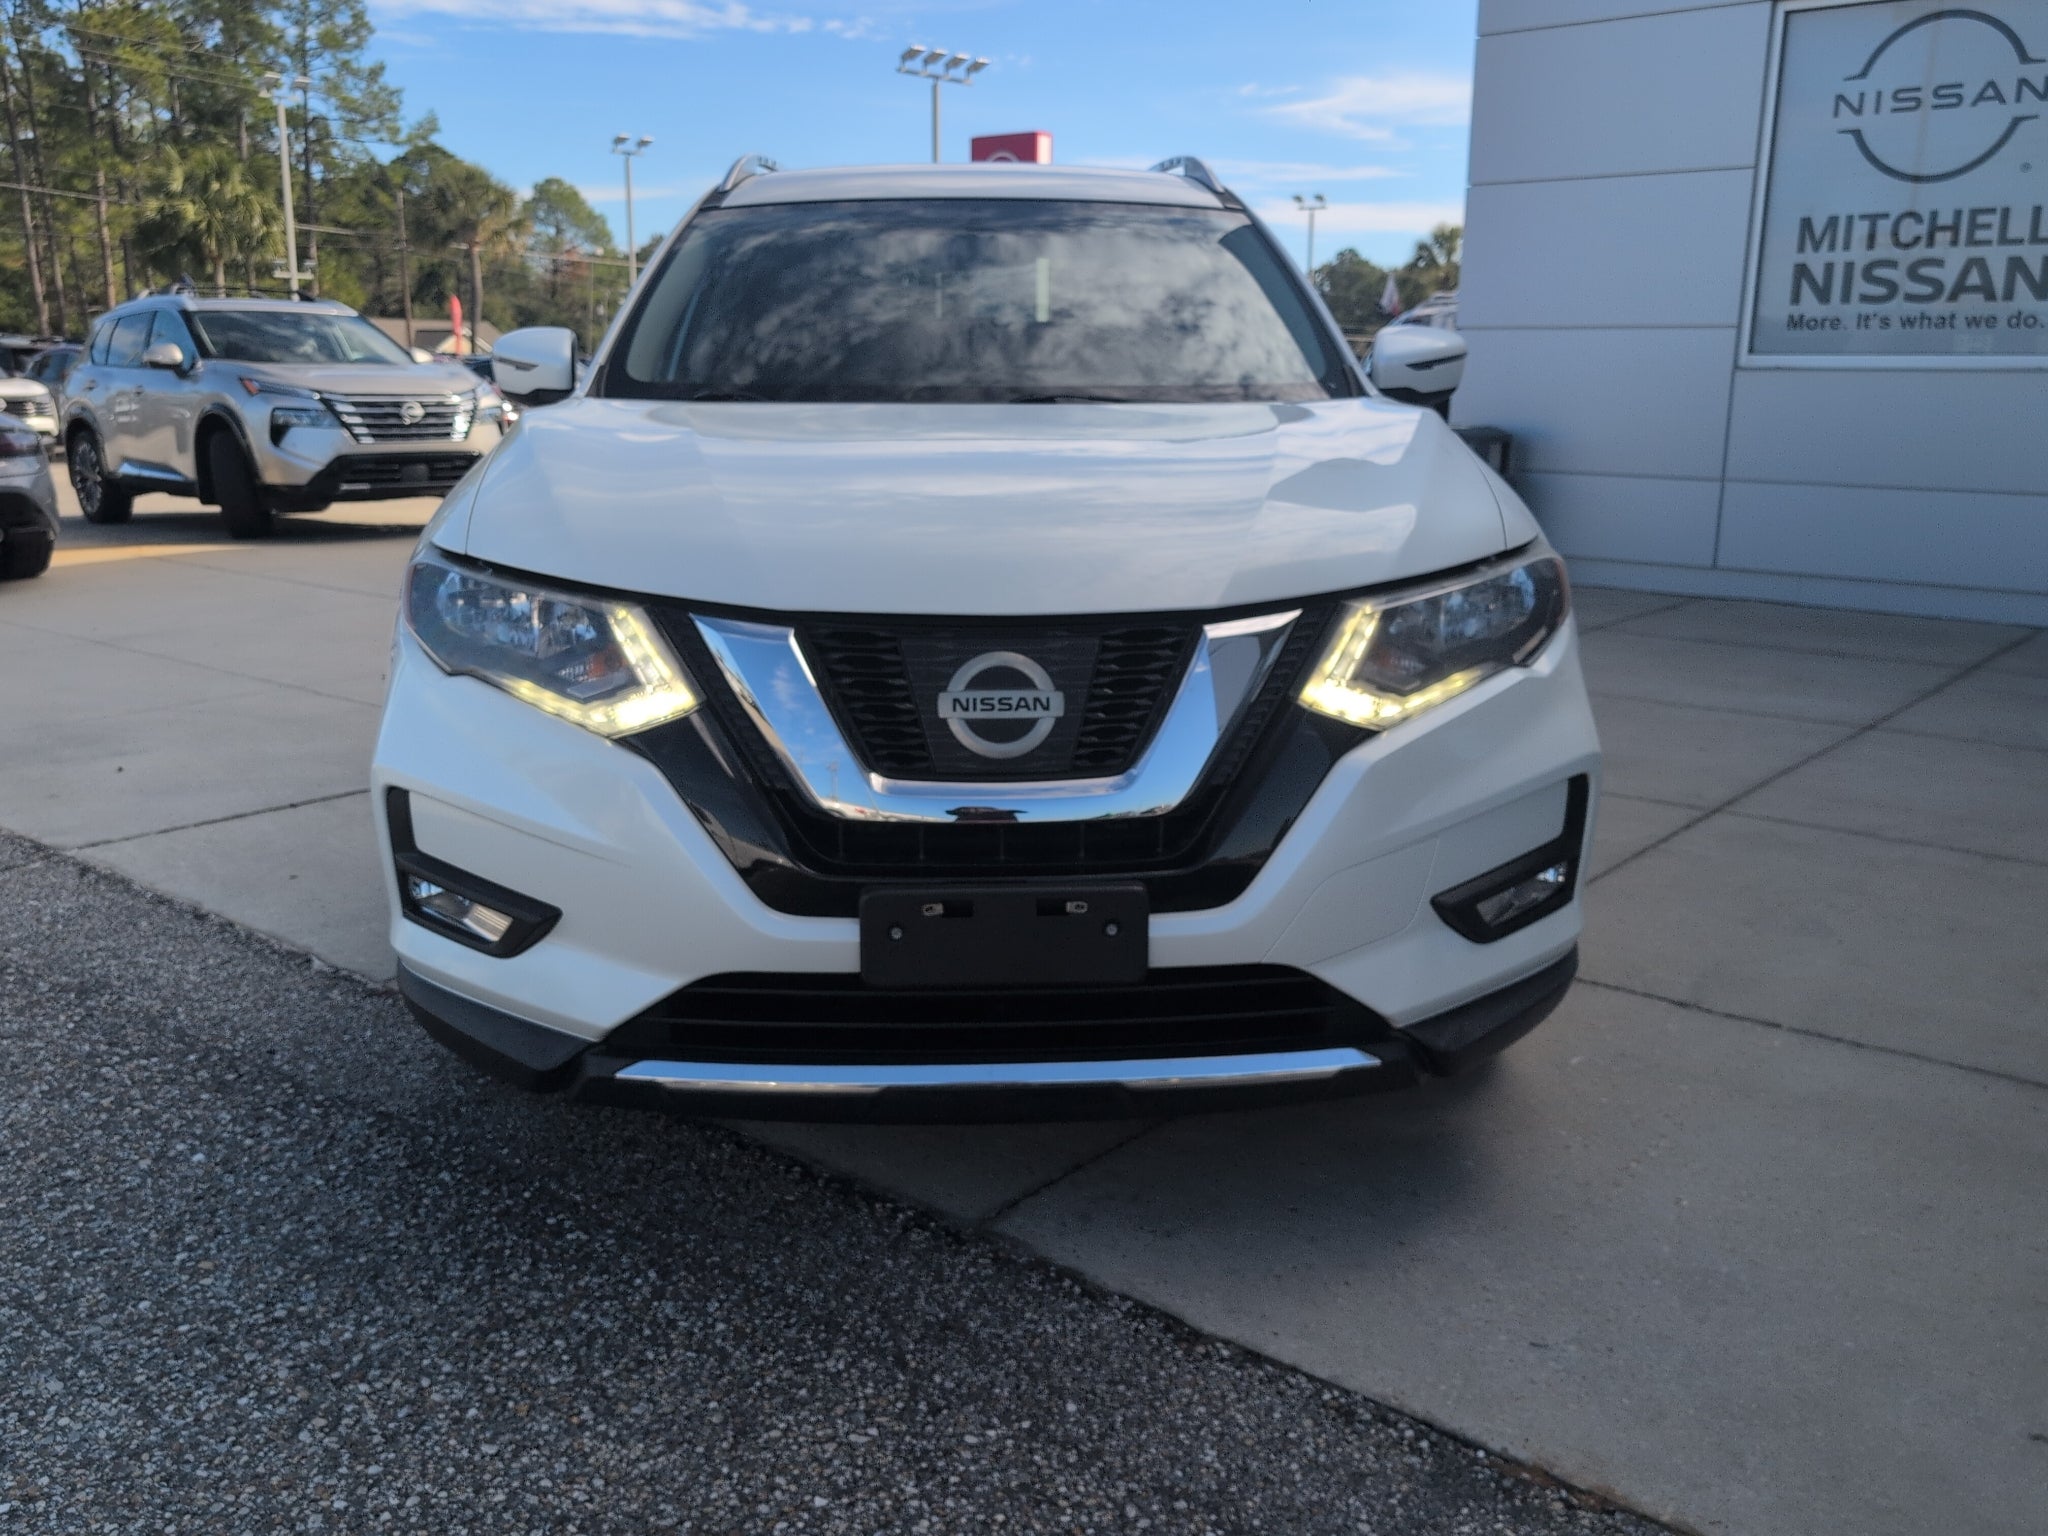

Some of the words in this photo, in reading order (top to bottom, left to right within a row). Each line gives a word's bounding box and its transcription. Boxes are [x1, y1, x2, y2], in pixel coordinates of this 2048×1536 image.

[1833, 77, 2048, 118] NISSAN
[1797, 206, 2048, 253] MITCHELL
[1790, 256, 2048, 305] NISSAN
[1786, 312, 1848, 332] More.
[1856, 311, 1891, 331] It's
[1899, 311, 1957, 330] what
[1964, 315, 1999, 329] we
[2006, 309, 2046, 330] do.
[952, 696, 1050, 712] NISSAN
